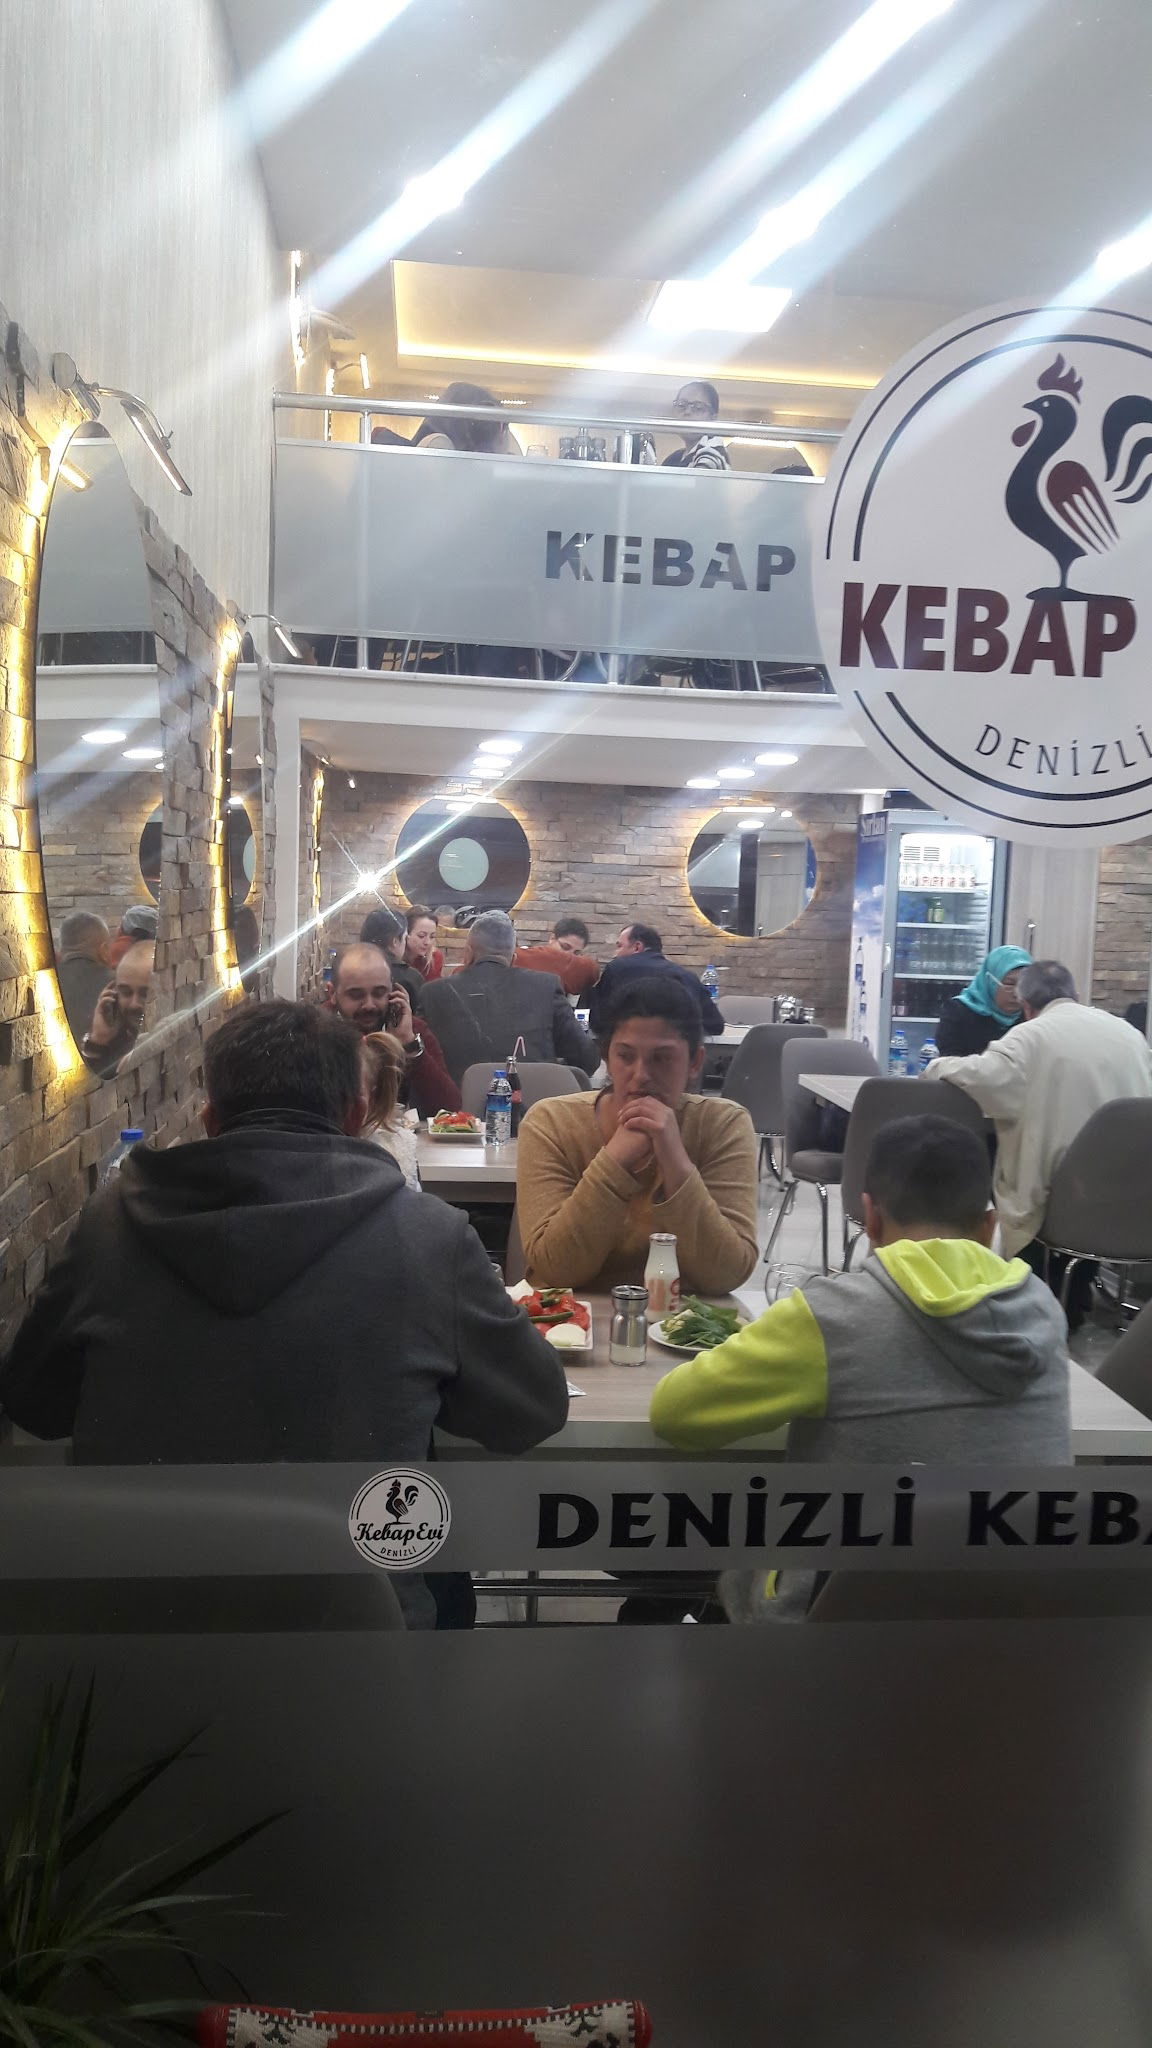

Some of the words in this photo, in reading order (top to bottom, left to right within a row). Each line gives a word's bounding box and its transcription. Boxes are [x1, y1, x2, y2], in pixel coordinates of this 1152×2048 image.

[545, 530, 796, 592] KEBAP
[840, 582, 1137, 678] KEBAP
[536, 1476, 916, 1548] DENİZLİ
[966, 1491, 1152, 1545] KEB
